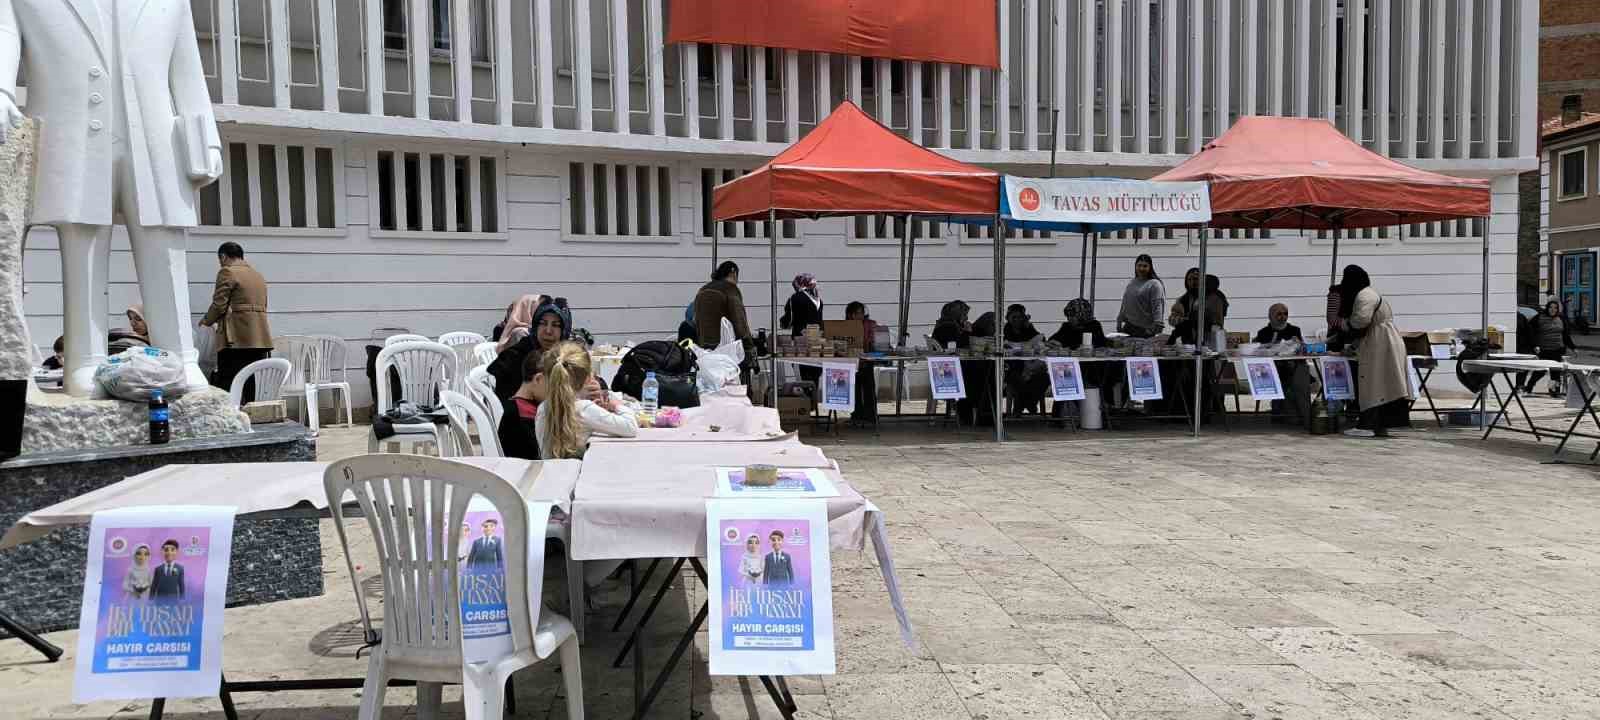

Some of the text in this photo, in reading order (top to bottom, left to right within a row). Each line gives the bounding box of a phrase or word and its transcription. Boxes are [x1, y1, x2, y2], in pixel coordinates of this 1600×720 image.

[1051, 192, 1201, 212] TAVAS MÜFTÜLÜĞÜ
[732, 623, 804, 635] HAYIR ÇARŞISI
[106, 642, 191, 654] HAYIR ÇARŞISI
